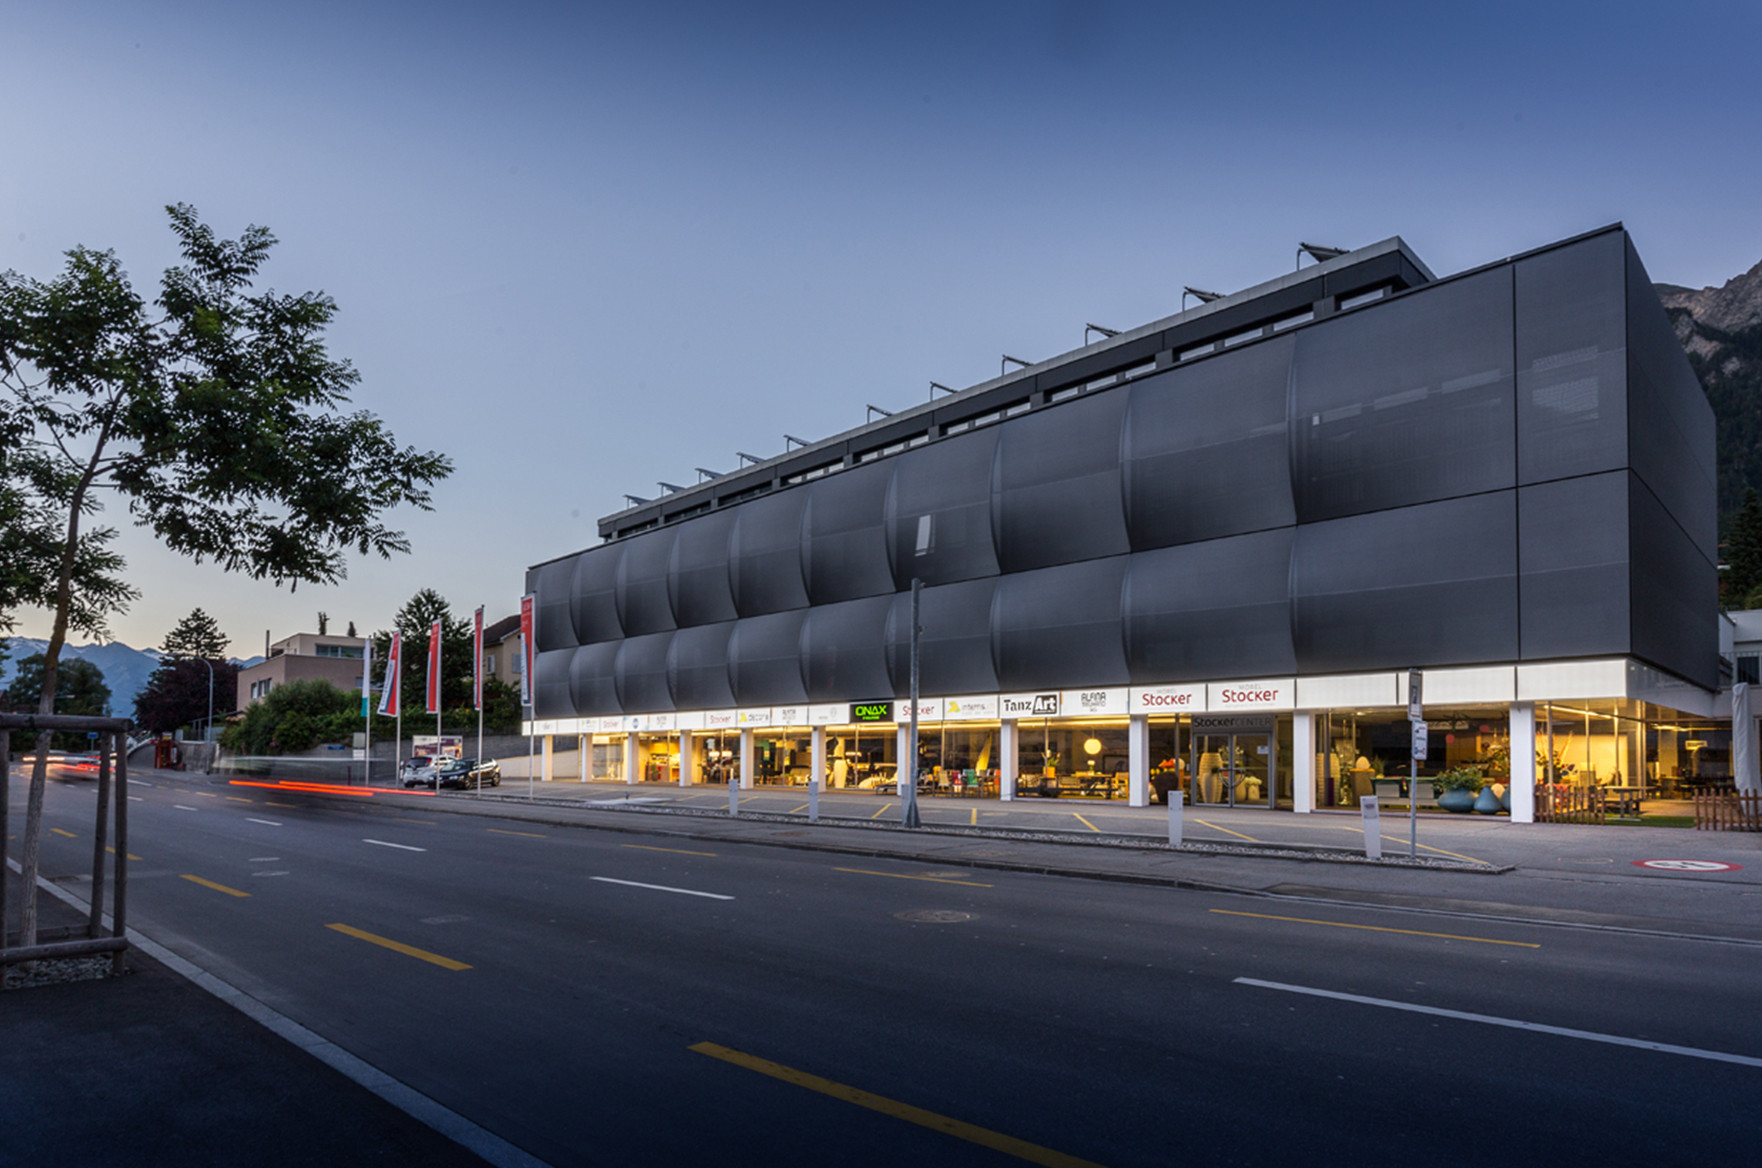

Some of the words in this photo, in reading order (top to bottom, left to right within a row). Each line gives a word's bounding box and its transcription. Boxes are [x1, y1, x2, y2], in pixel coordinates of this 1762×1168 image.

[1142, 693, 1192, 706] Stocker
[1222, 689, 1279, 703] Stocker
[855, 705, 887, 716] ONAX
[902, 705, 935, 716] Stcker
